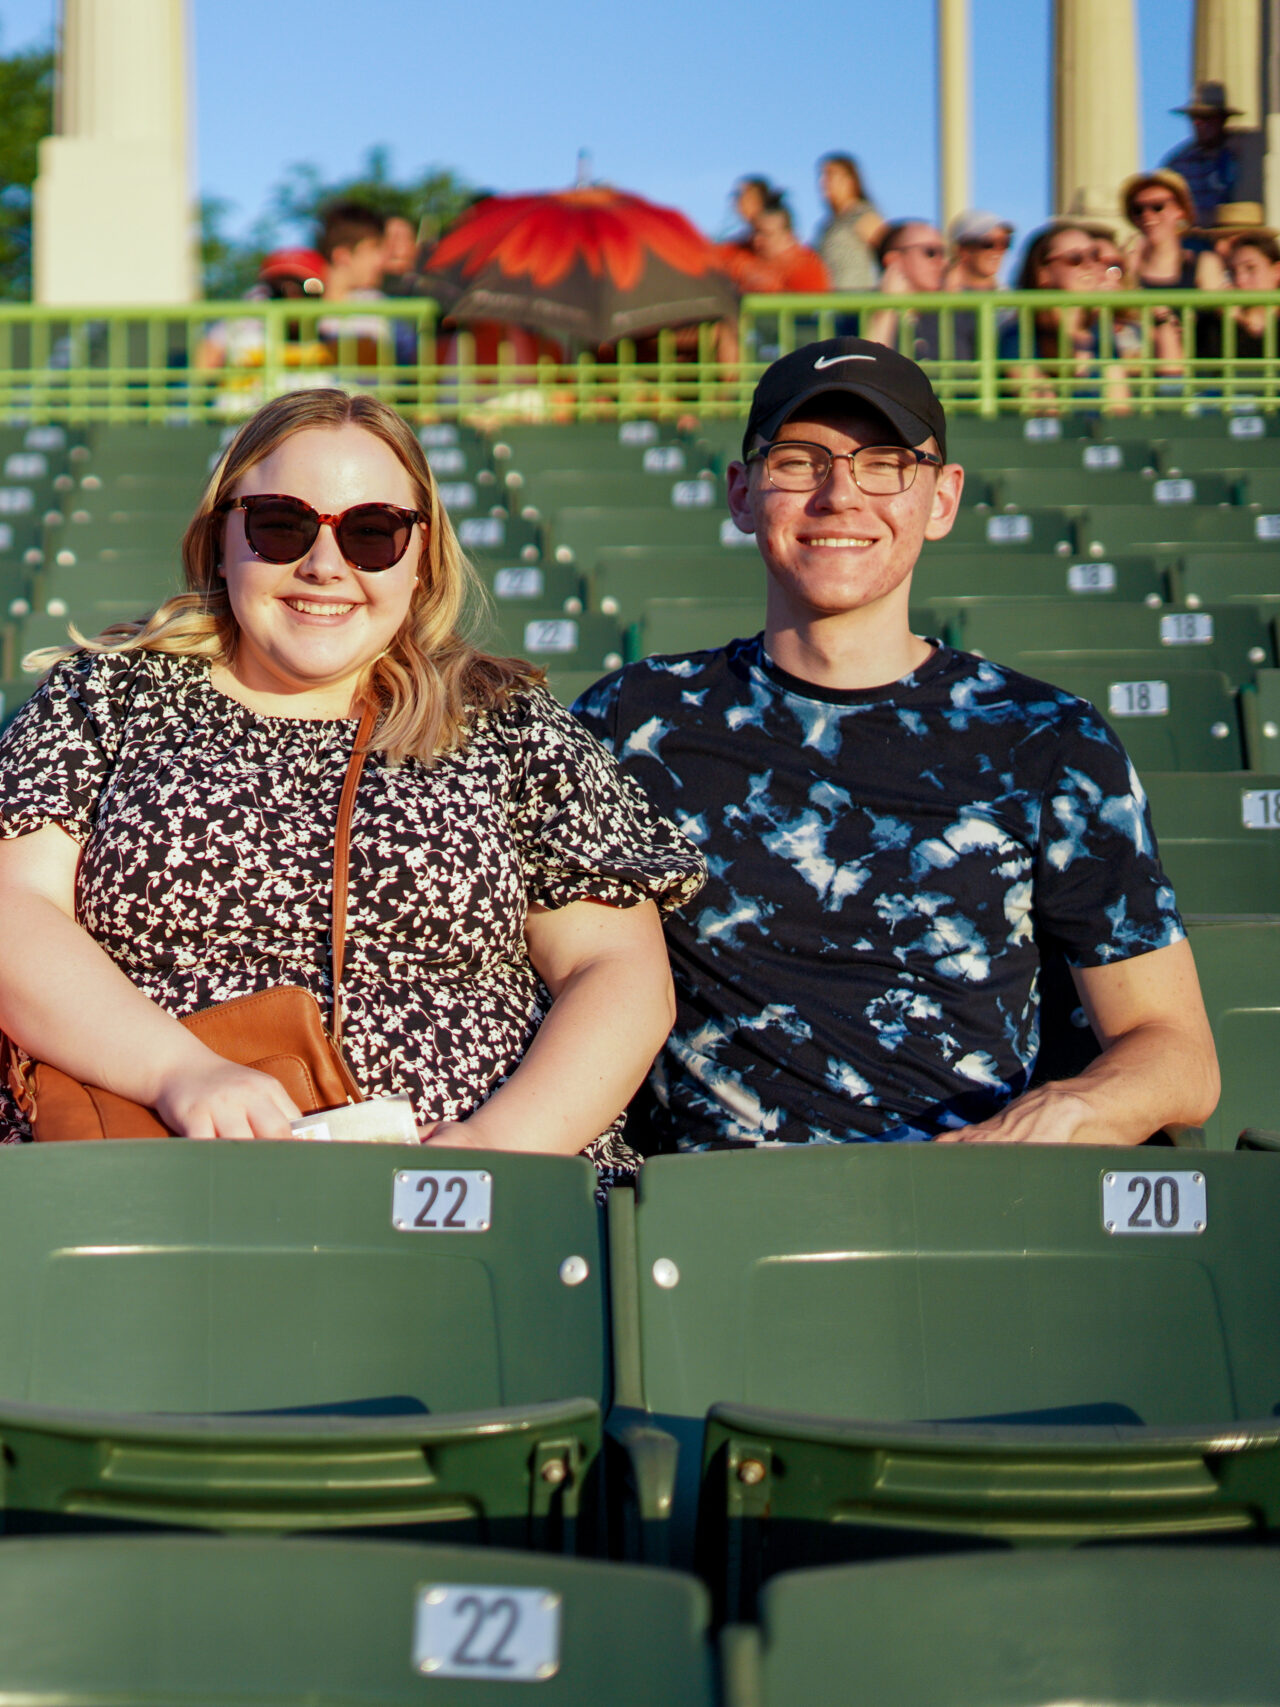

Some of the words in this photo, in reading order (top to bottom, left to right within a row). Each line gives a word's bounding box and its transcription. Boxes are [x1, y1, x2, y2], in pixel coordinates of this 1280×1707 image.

[537, 621, 560, 644] 22
[1174, 615, 1195, 638] 18
[1125, 683, 1151, 710] 18
[413, 1176, 467, 1228] 22
[1127, 1176, 1180, 1228] 20
[453, 1595, 521, 1667] 22
